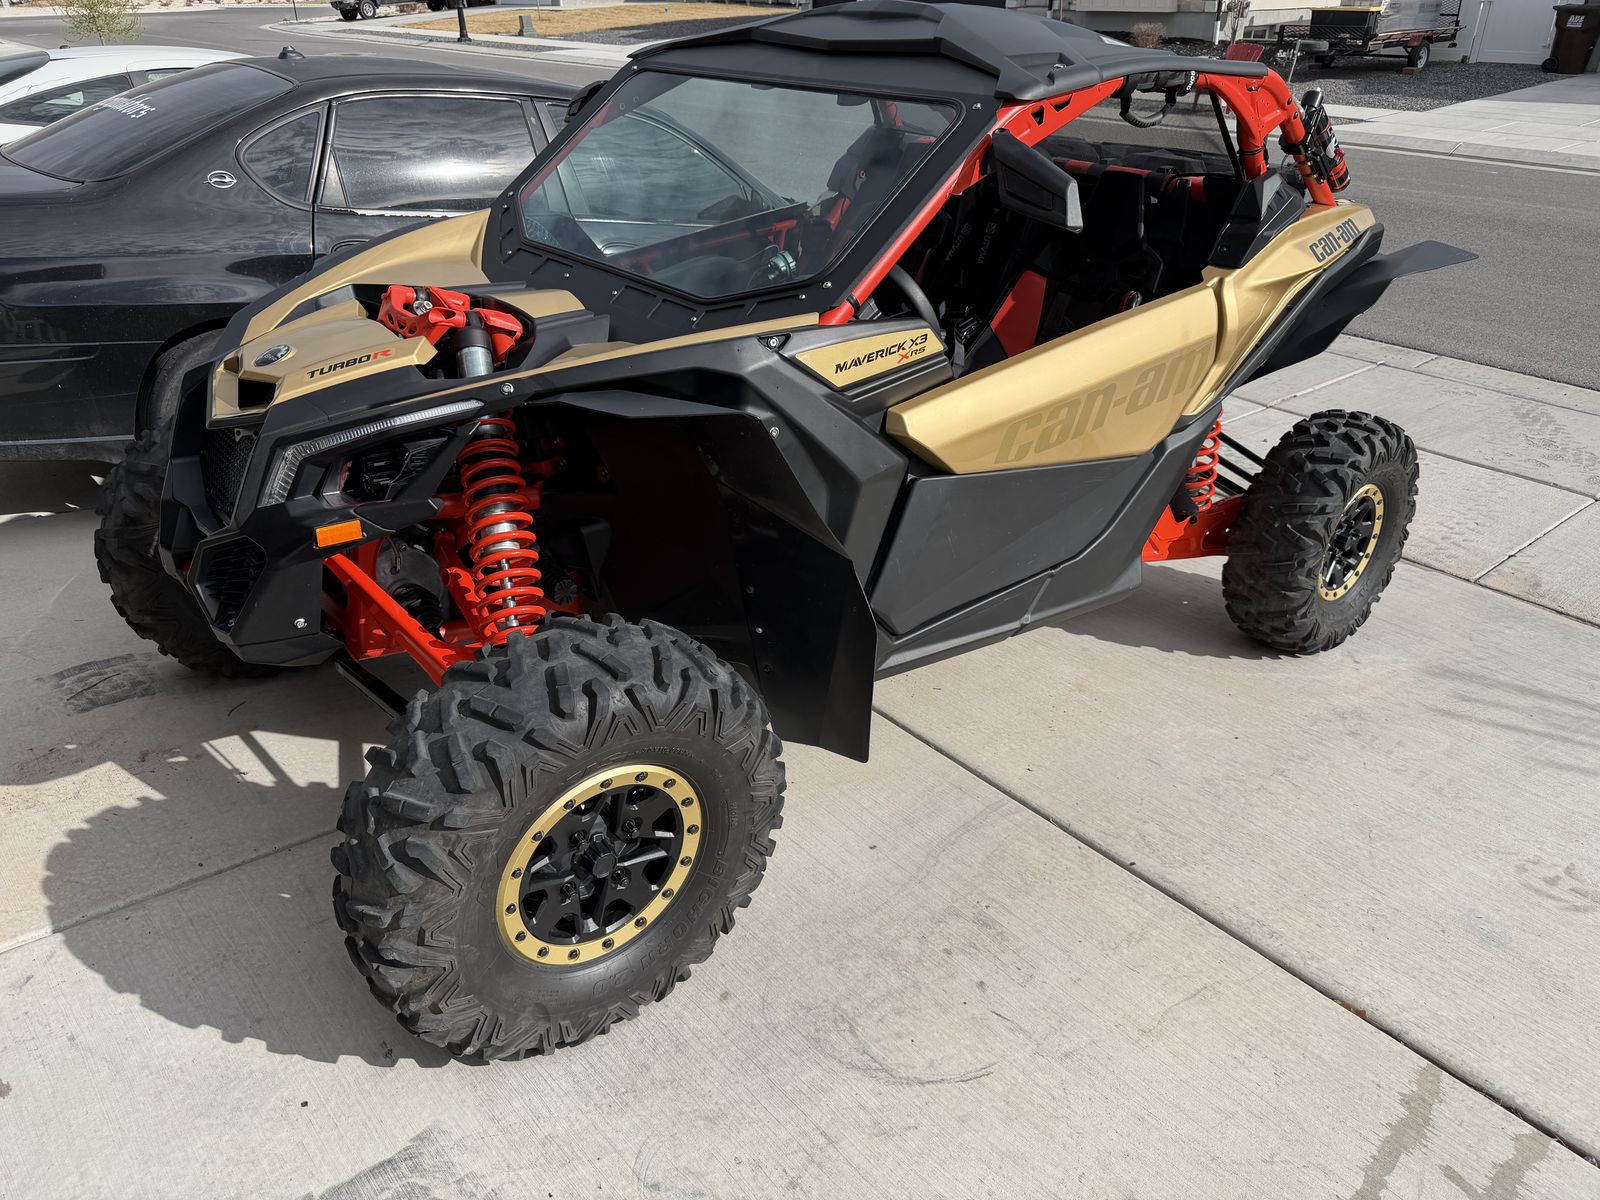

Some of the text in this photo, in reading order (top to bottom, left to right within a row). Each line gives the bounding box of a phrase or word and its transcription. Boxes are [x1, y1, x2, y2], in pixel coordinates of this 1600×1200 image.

[1309, 218, 1360, 263] can-am
[835, 333, 928, 374] MAVERICK X3
[994, 341, 1213, 465] can-am
